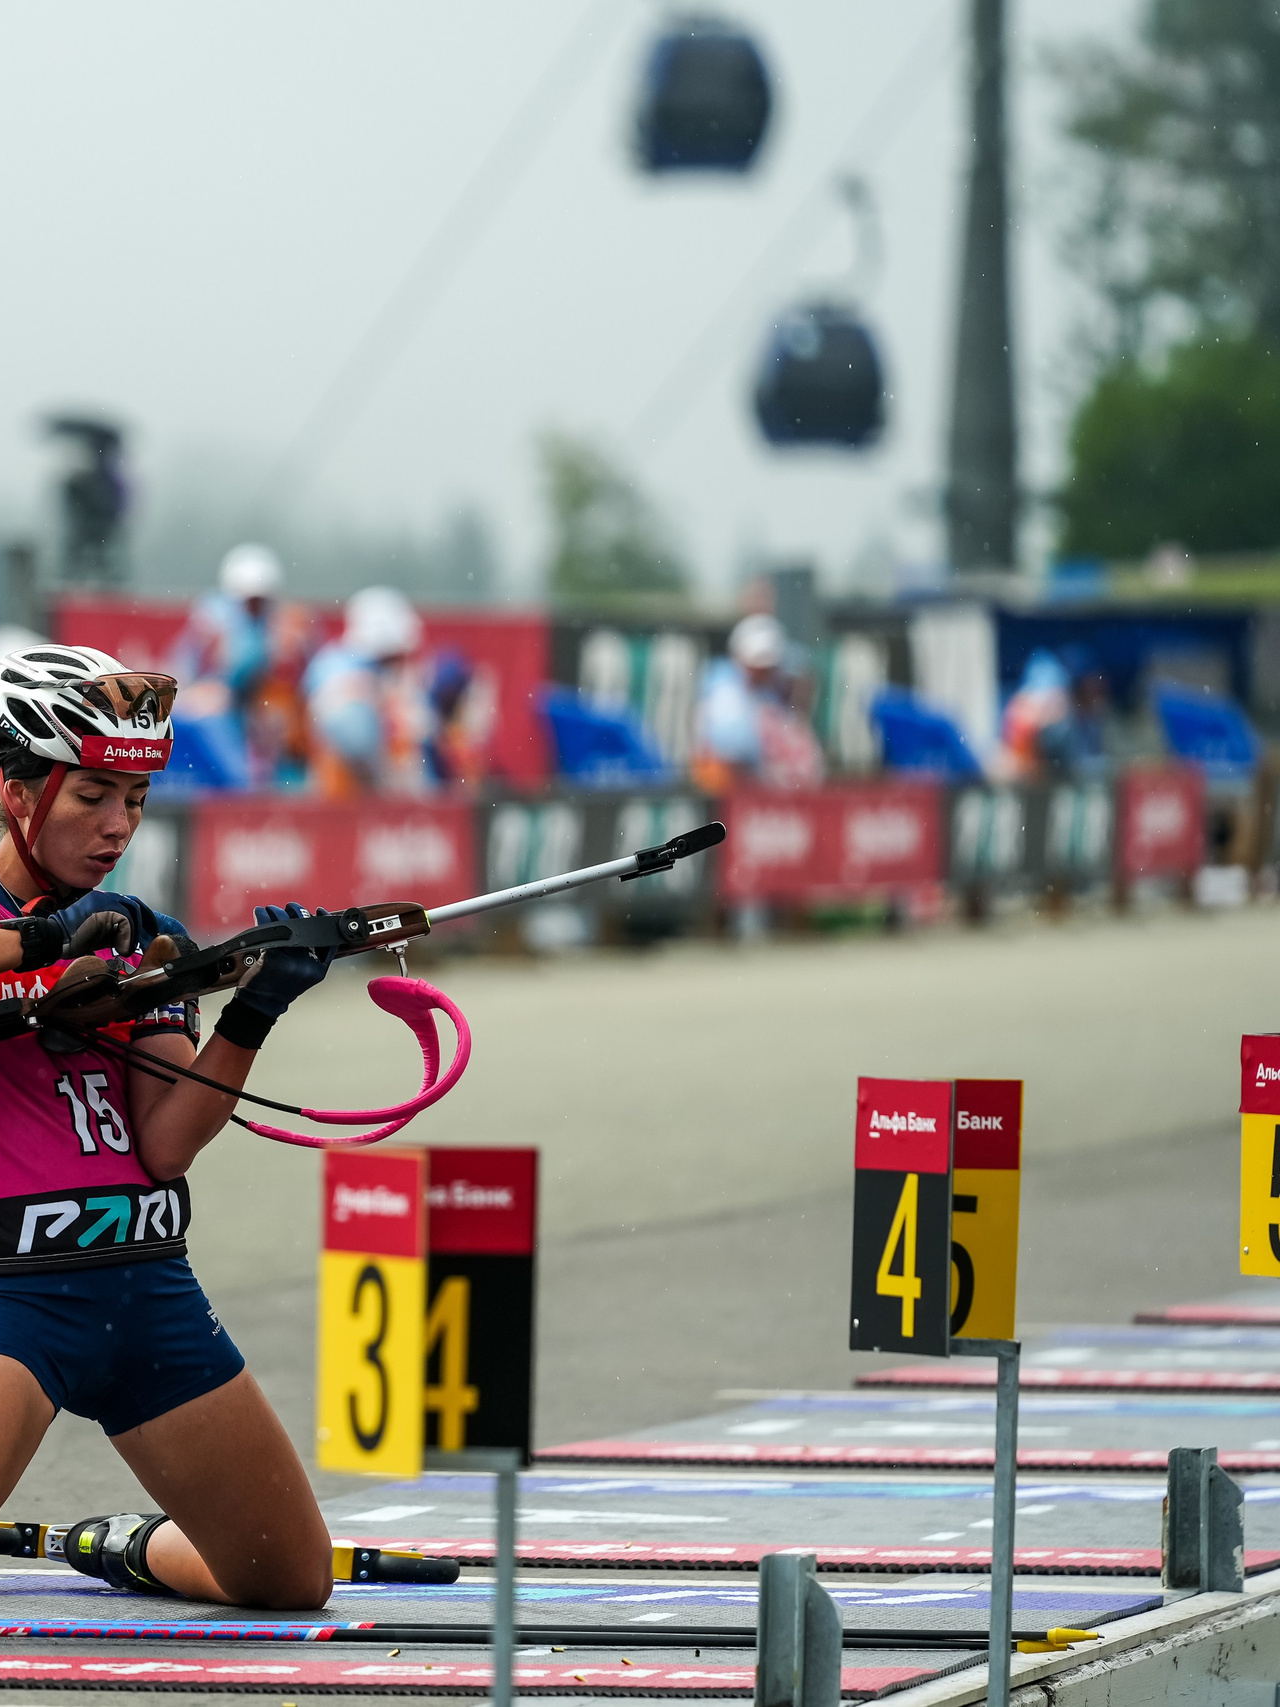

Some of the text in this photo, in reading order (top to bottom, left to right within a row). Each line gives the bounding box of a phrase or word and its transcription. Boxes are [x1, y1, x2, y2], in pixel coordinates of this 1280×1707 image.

[0, 719, 29, 747] PARI
[131, 709, 151, 730] 15
[104, 745, 143, 761] Альфа
[1256, 1062, 1280, 1084] Аль
[55, 1071, 131, 1154] 15
[869, 1109, 937, 1136] Альфа Банк
[957, 1110, 1003, 1131] Банк
[16, 1189, 182, 1255] PARI
[876, 1172, 922, 1338] 4
[347, 1262, 392, 1455] 3
[425, 1274, 480, 1454] 4
